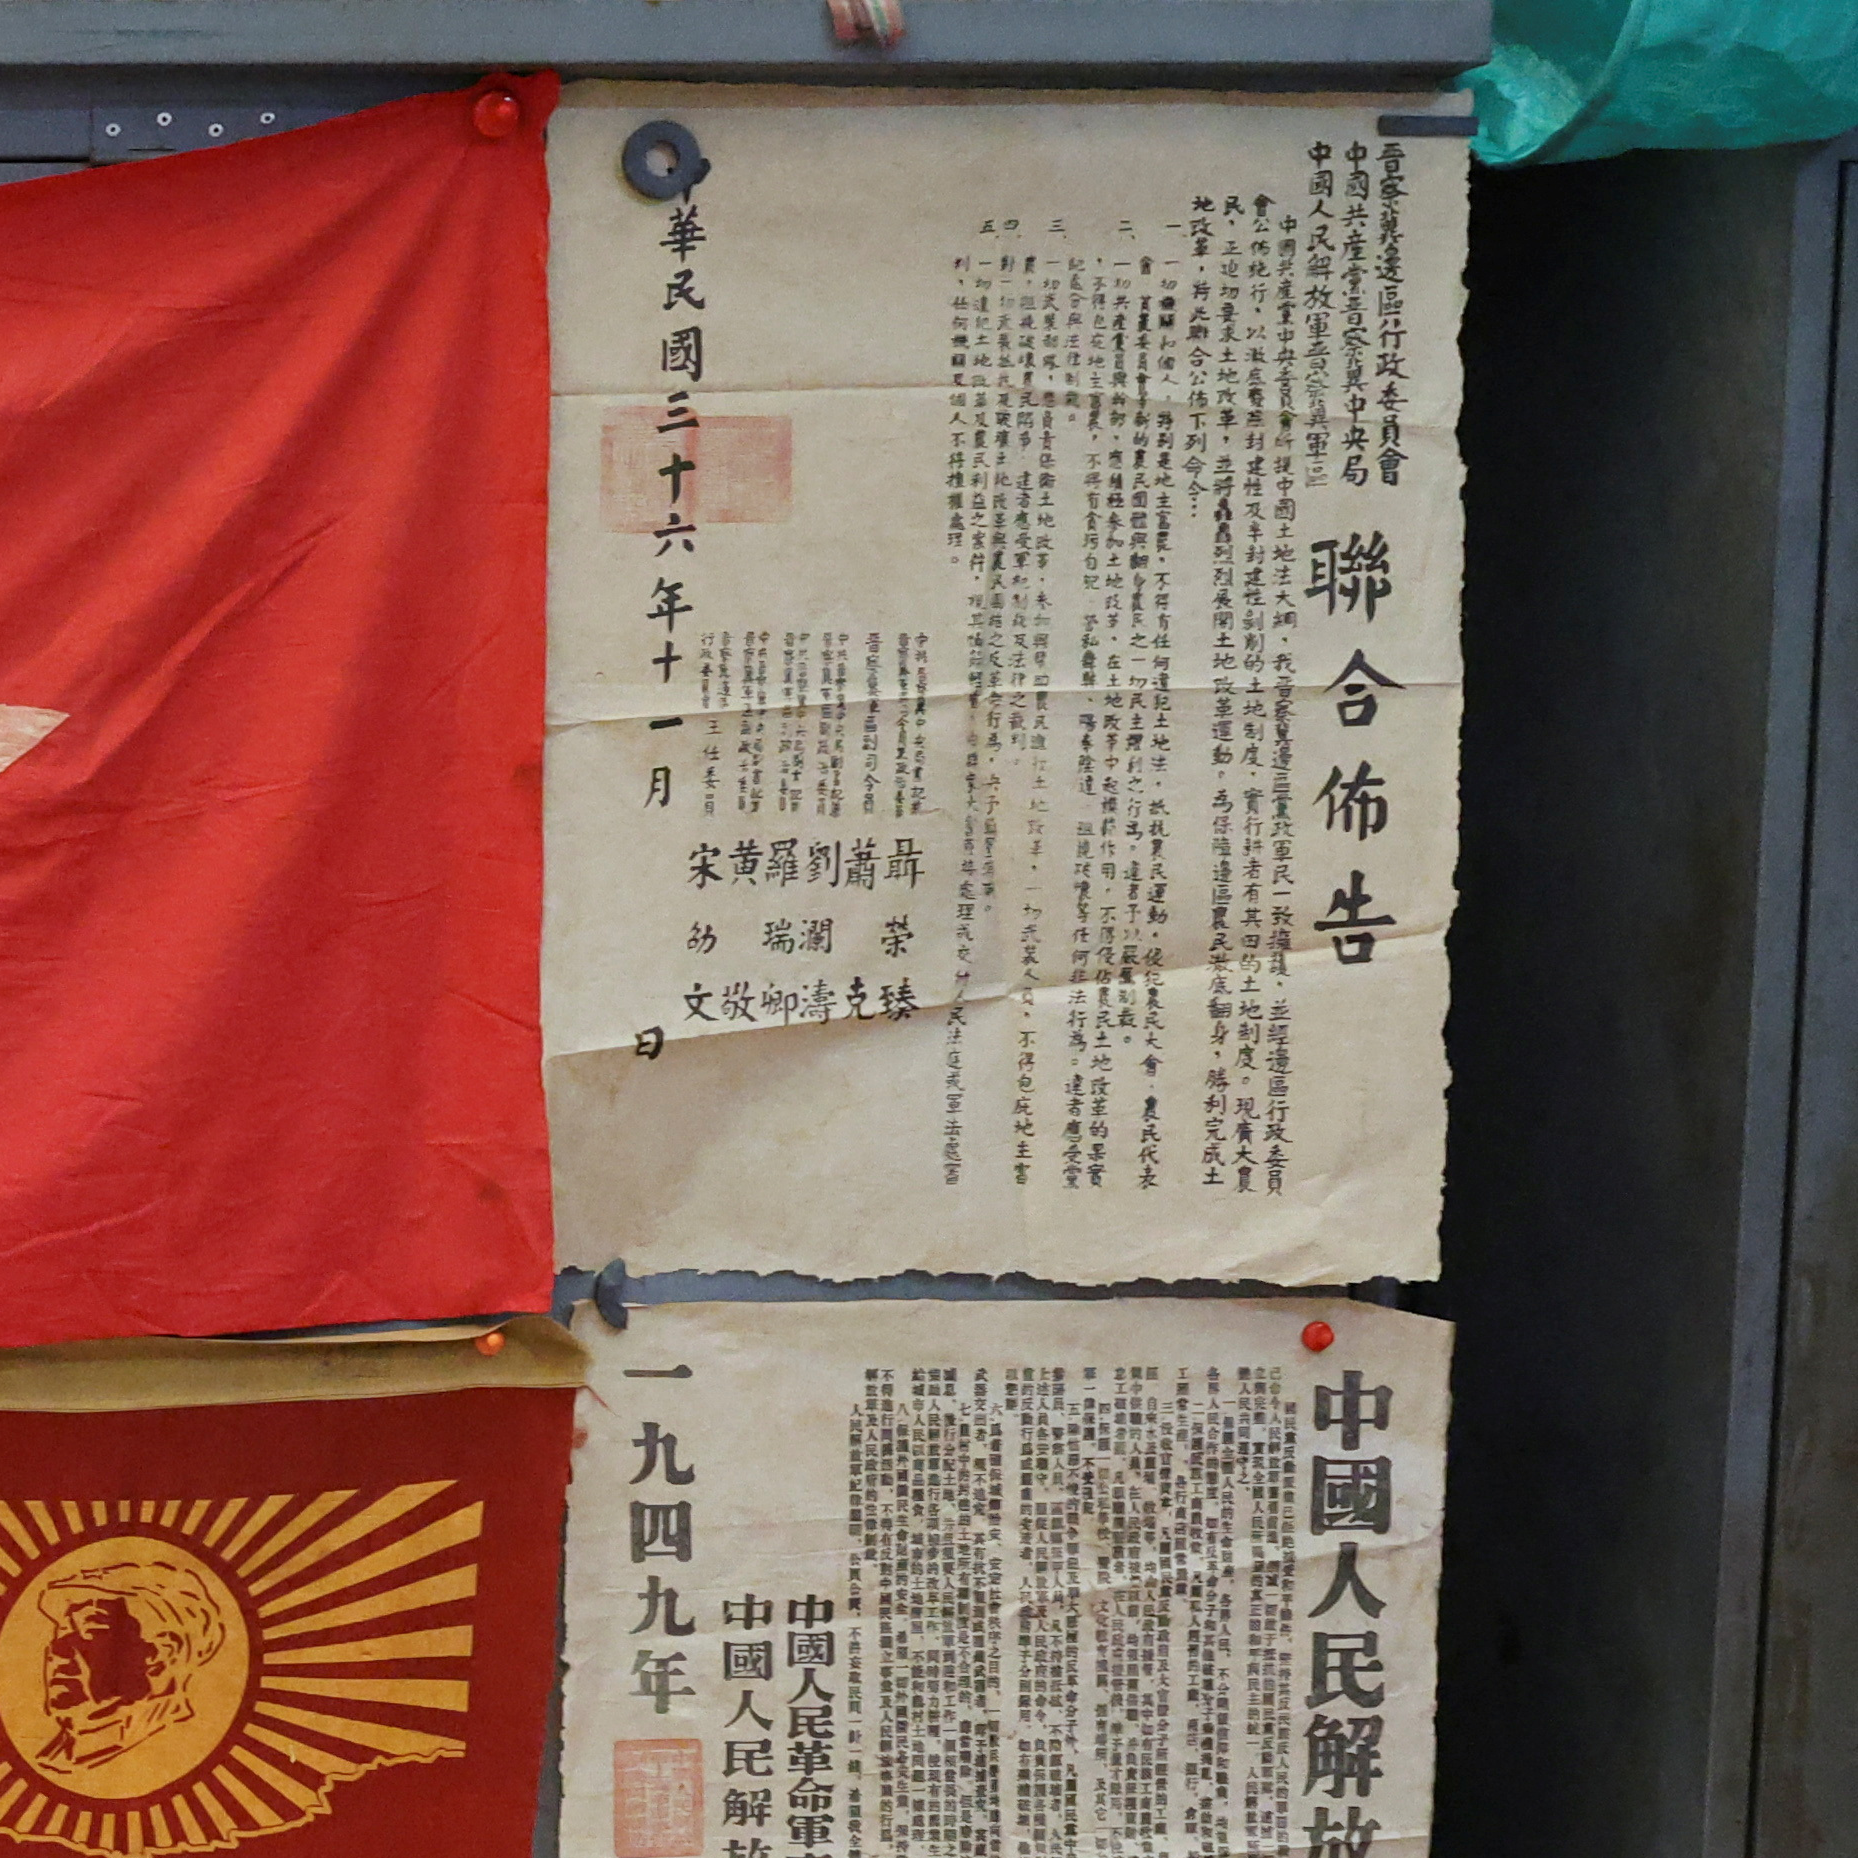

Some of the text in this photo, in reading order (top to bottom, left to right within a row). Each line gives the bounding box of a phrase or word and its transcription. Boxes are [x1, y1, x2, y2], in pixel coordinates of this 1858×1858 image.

[1304, 530, 1406, 967] 聯合佈告
[760, 839, 800, 1025] 羅瑞卿
[798, 839, 841, 1025] 劉瀾濤
[843, 838, 881, 1021] 蕭克
[880, 838, 925, 1022] 聶榮臻
[621, 1362, 697, 1716] 一九四九年
